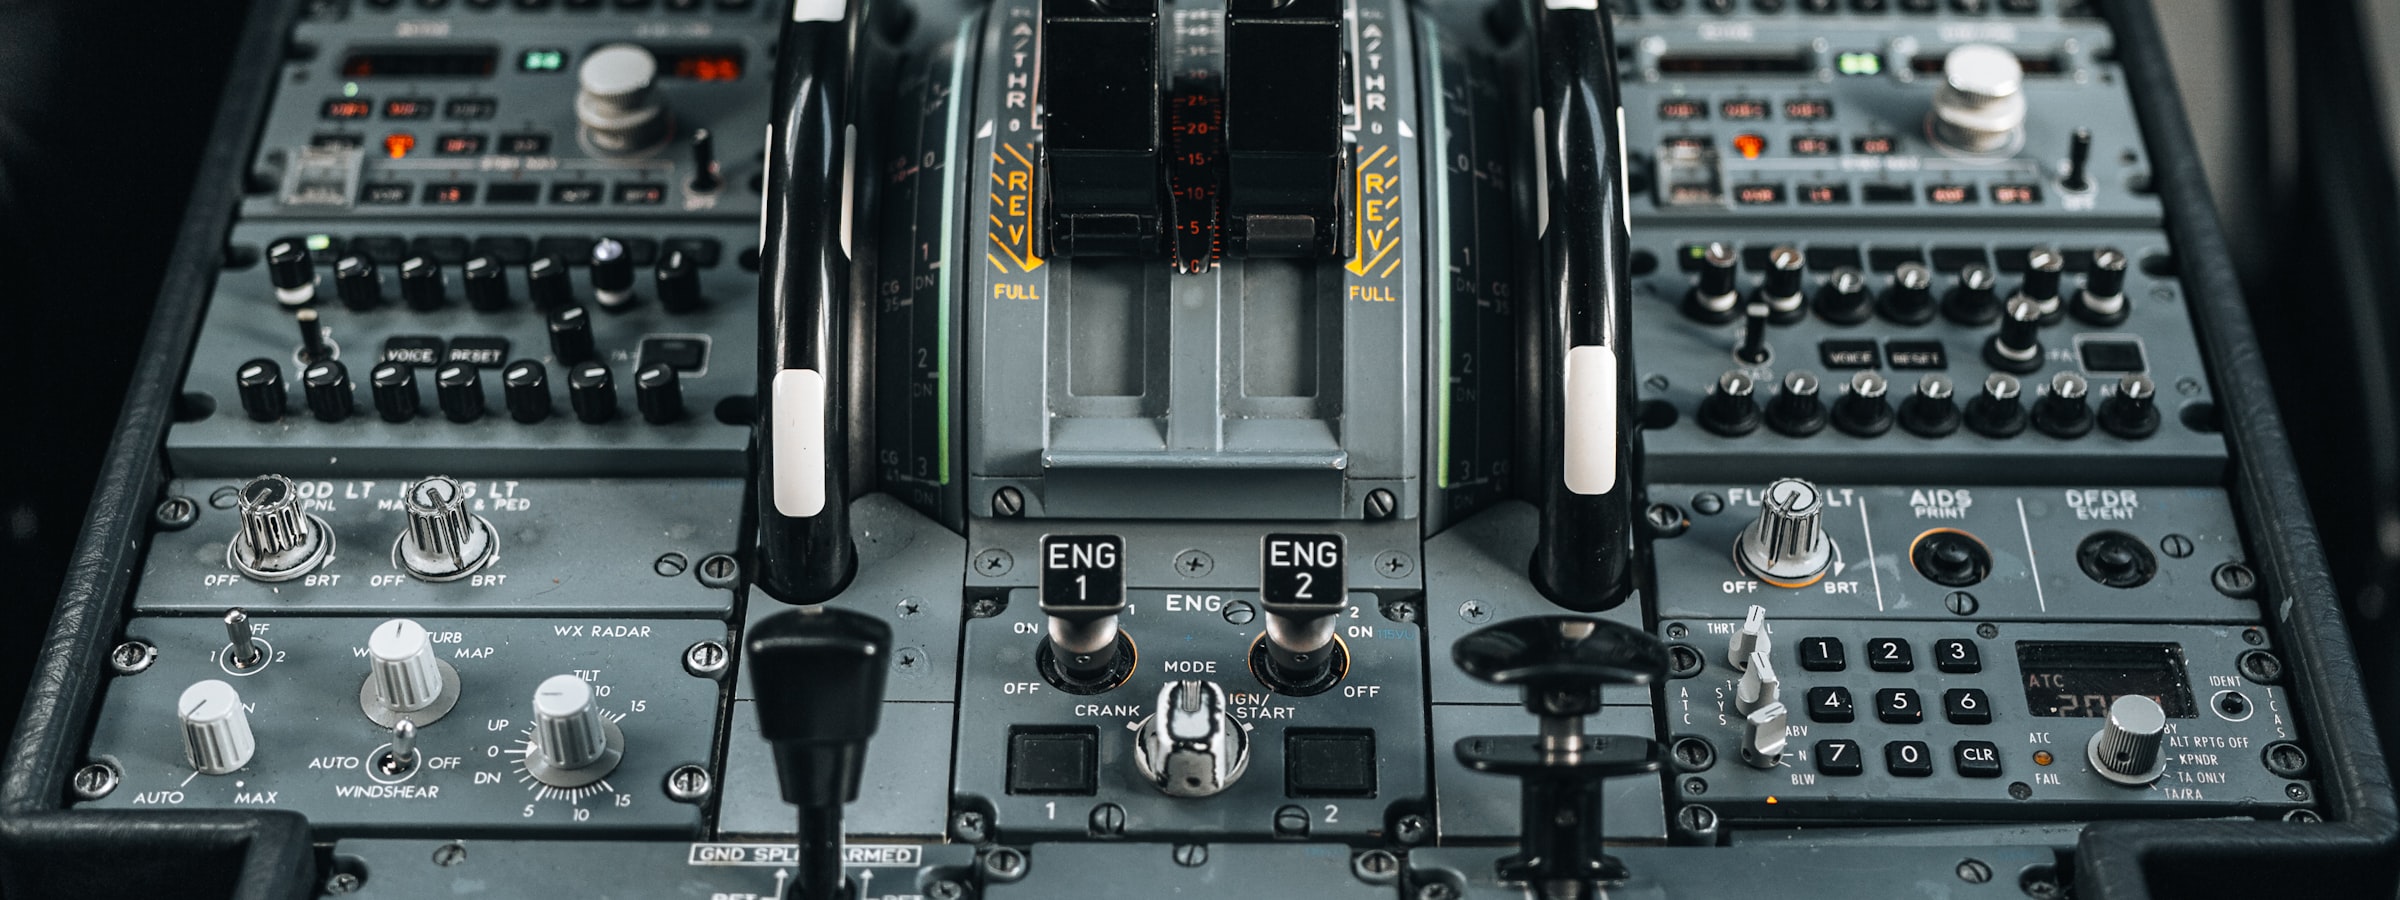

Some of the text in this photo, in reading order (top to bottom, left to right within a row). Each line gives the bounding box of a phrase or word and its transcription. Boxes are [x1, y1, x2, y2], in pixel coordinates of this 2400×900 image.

[1187, 122, 1208, 135] 20
[1188, 152, 1205, 166] 15
[1187, 186, 1204, 200] 10
[1008, 170, 1028, 246] REV
[1365, 173, 1385, 250] REV
[1190, 220, 1200, 235] 5
[915, 273, 935, 290] DN
[994, 283, 1040, 300] FULL
[1350, 285, 1396, 302] FULL
[388, 349, 434, 362] VOICE
[451, 349, 502, 363] RESET
[918, 347, 928, 368] 2
[1831, 351, 1873, 364] VOICE
[1892, 352, 1939, 365] RESET
[1462, 352, 1473, 374] 2
[345, 482, 375, 499] LT
[489, 482, 519, 499] LT
[1826, 489, 1855, 507] LT
[1910, 489, 1972, 507] AIDS
[2065, 489, 2138, 508] DFDR
[303, 499, 336, 511] PNL
[378, 498, 531, 512] MA & PED
[1915, 505, 1966, 519] PRINT
[2077, 507, 2133, 520] EVENT
[1050, 543, 1116, 569] ENG
[1270, 541, 1337, 568] ENG
[204, 575, 240, 587] OFF
[305, 575, 340, 587] BRT
[370, 575, 405, 587] OFF
[471, 575, 507, 587] BRT
[1075, 575, 1086, 600] 1
[1295, 572, 1313, 598] 2
[1722, 581, 1757, 594] OFF
[1824, 581, 1858, 594] BRT
[1128, 604, 1135, 615] 1
[1166, 594, 1222, 613] ENG
[1350, 606, 1360, 618] 2
[250, 624, 270, 635] FF
[554, 625, 651, 638] WX RADAR
[1014, 622, 1039, 634] ON
[1348, 626, 1373, 638] ON
[1707, 623, 1736, 634] THRT
[210, 650, 216, 662] 1
[454, 648, 494, 659] MAP
[1819, 641, 1828, 659] 1
[1882, 642, 1899, 659] 2
[1950, 642, 1965, 659] 3
[276, 651, 286, 663] 2
[1164, 661, 1217, 673] MODE
[574, 670, 601, 682] TILT
[2029, 674, 2065, 688] ATC
[2209, 675, 2241, 687] IDENT
[595, 685, 611, 697] 10
[1004, 682, 1041, 695] OFF
[1344, 686, 1381, 698] OFF
[631, 700, 646, 712] 15
[1229, 693, 1270, 707] IGN/
[1681, 687, 1691, 725] ATC
[1715, 687, 1727, 725] SYS
[1824, 691, 1841, 708] 4
[1893, 692, 1908, 709] 5
[1961, 692, 1976, 709] 6
[1075, 704, 1140, 717] CRANK
[1236, 707, 1296, 719] START
[2267, 687, 2285, 738] TCAS
[487, 719, 509, 731] UP
[1785, 726, 1808, 737] ABV
[2029, 732, 2051, 744] ATC
[2170, 737, 2249, 748] ALT RPTG OFF
[487, 746, 498, 757] 0
[1799, 750, 1807, 761] N
[1829, 744, 1846, 762] 7
[1901, 745, 1919, 763] 0
[1963, 748, 1995, 761] CLR
[309, 756, 359, 769] AUTO
[428, 756, 461, 769] OFF
[2179, 754, 2219, 766] XPNDR
[474, 772, 501, 784] DN
[1791, 774, 1815, 785] BLW
[2035, 773, 2061, 785] FAIL
[2178, 771, 2226, 784] TA ONLY
[133, 790, 185, 804] AUTO
[234, 791, 278, 804] MAX
[335, 785, 440, 798] WINDSHEAR
[2164, 788, 2203, 800] TA/RA
[615, 794, 631, 807] 15
[523, 805, 535, 817] 5
[574, 808, 590, 821] 10
[1045, 802, 1055, 820] 1
[1324, 805, 1339, 823] 2
[700, 847, 745, 861] GND
[754, 848, 799, 862] SPL
